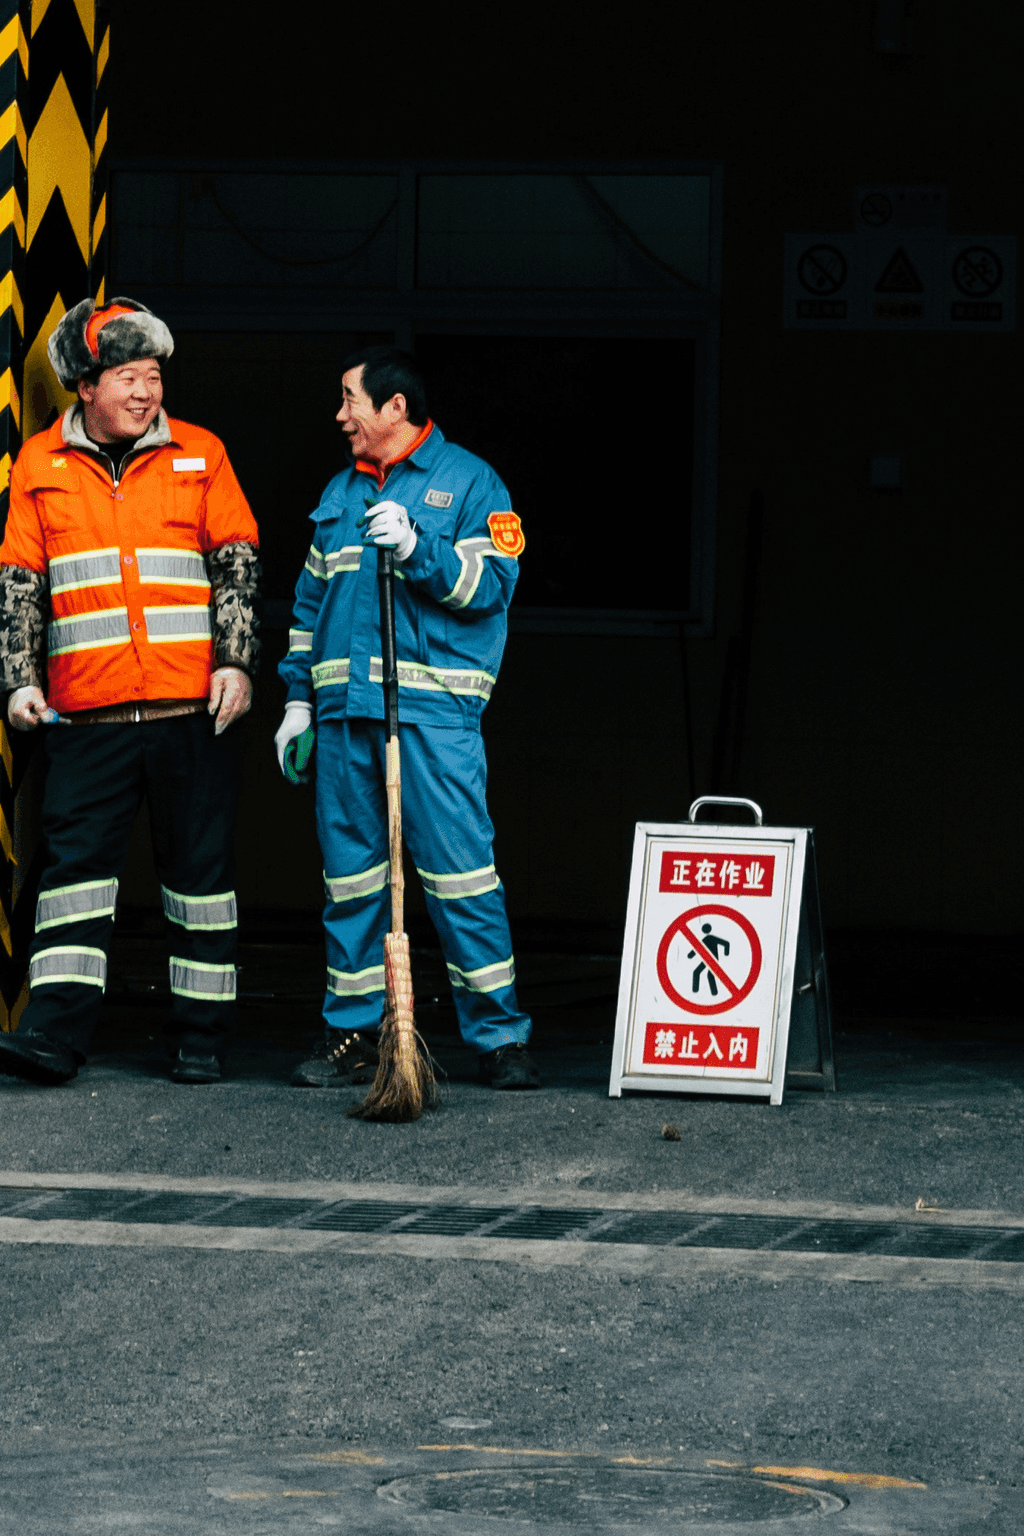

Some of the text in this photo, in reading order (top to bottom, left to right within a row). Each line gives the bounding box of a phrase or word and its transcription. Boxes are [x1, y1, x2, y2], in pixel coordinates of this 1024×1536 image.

[669, 858, 765, 890] 正在作业
[654, 1028, 749, 1063] 禁止入内
